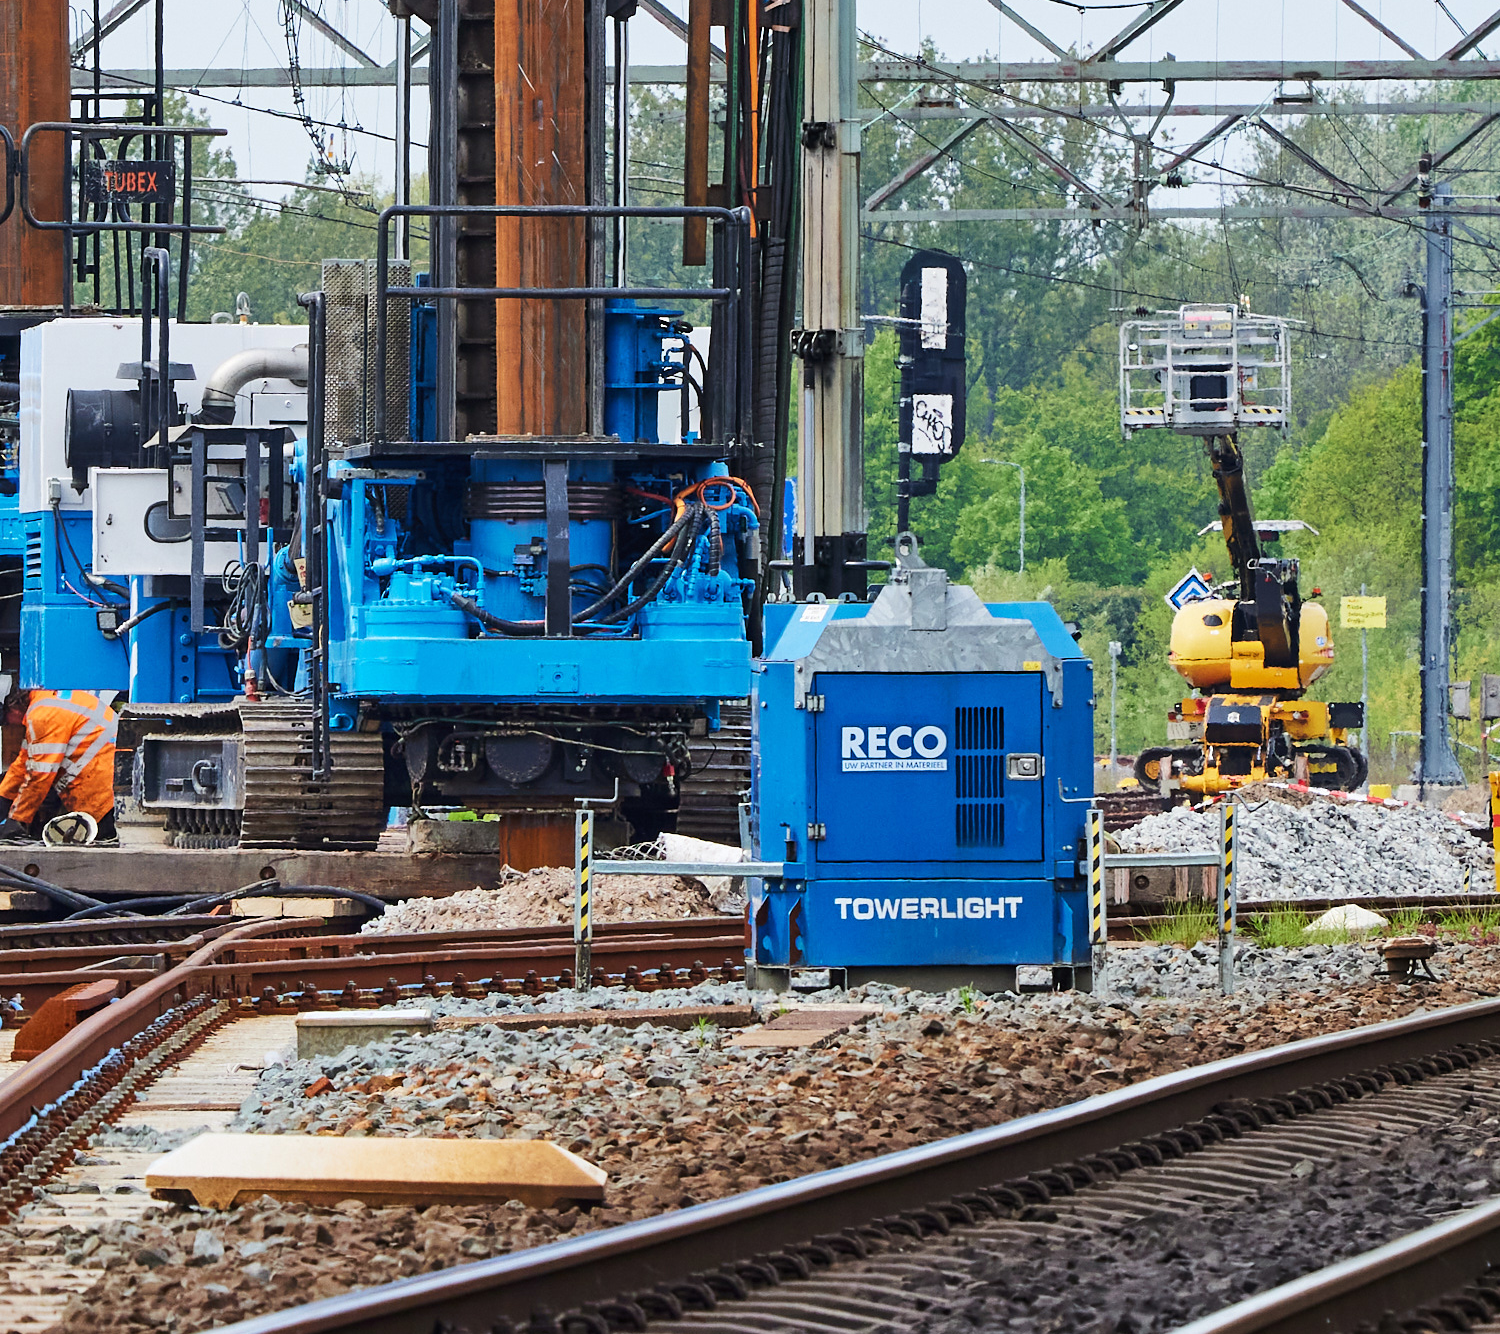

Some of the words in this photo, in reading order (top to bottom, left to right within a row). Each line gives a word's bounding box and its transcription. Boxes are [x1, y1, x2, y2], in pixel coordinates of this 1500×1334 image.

[104, 171, 157, 192] TUBEX
[841, 725, 948, 759] RECO
[860, 761, 893, 769] PARTNER
[906, 761, 944, 769] MATERIEEL
[834, 896, 1023, 920] TOWERLIGHT
